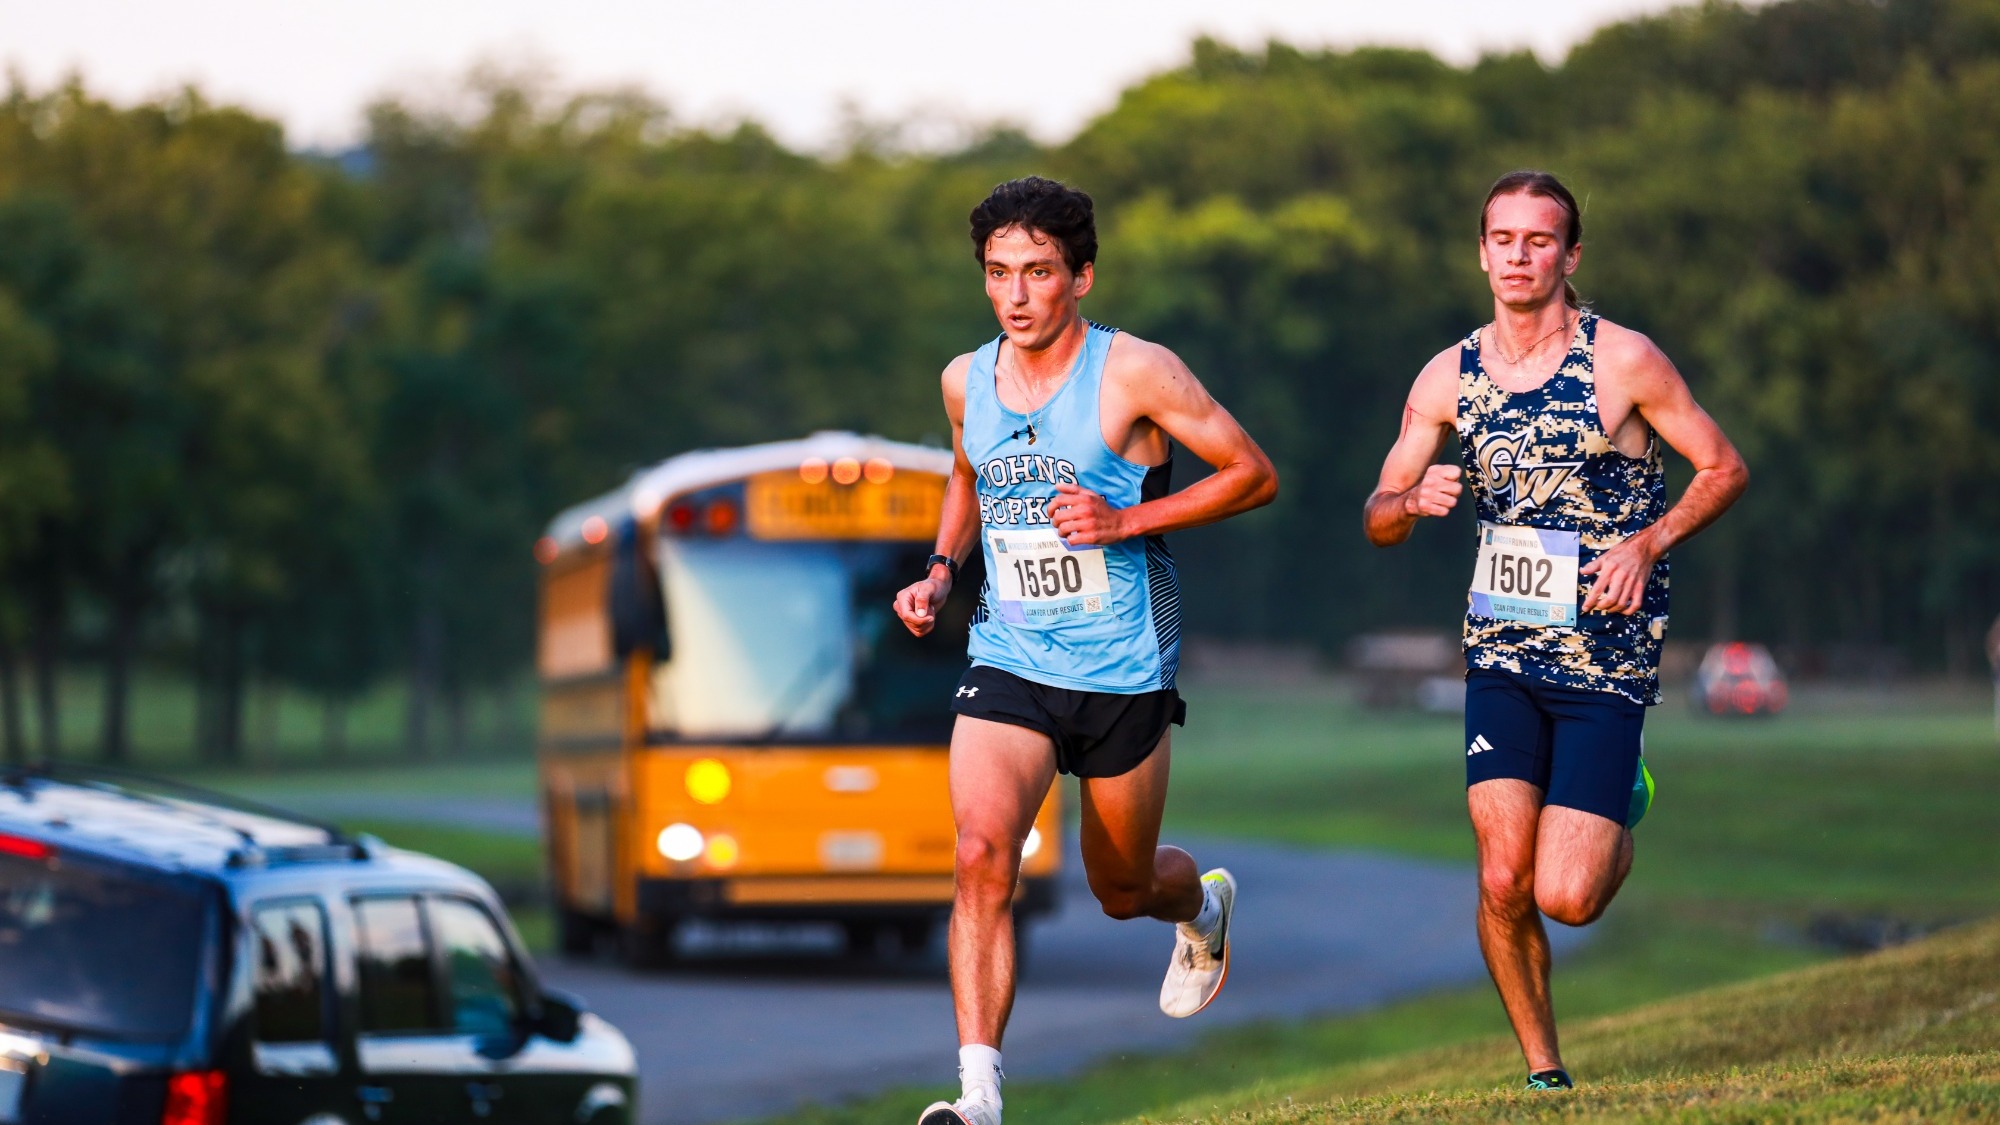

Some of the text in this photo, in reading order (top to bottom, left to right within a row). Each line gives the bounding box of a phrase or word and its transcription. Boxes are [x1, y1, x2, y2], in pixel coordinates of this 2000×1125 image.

[979, 454, 1080, 489] JOHNS
[1476, 425, 1585, 513] GW
[980, 492, 1106, 525] HOPK
[1013, 555, 1083, 598] 1550
[1490, 552, 1553, 598] 1502
[1026, 603, 1084, 617] SCAN FOR LIVE RESULTS
[1493, 603, 1549, 618] SCAN FOR LIVE RESULTS
